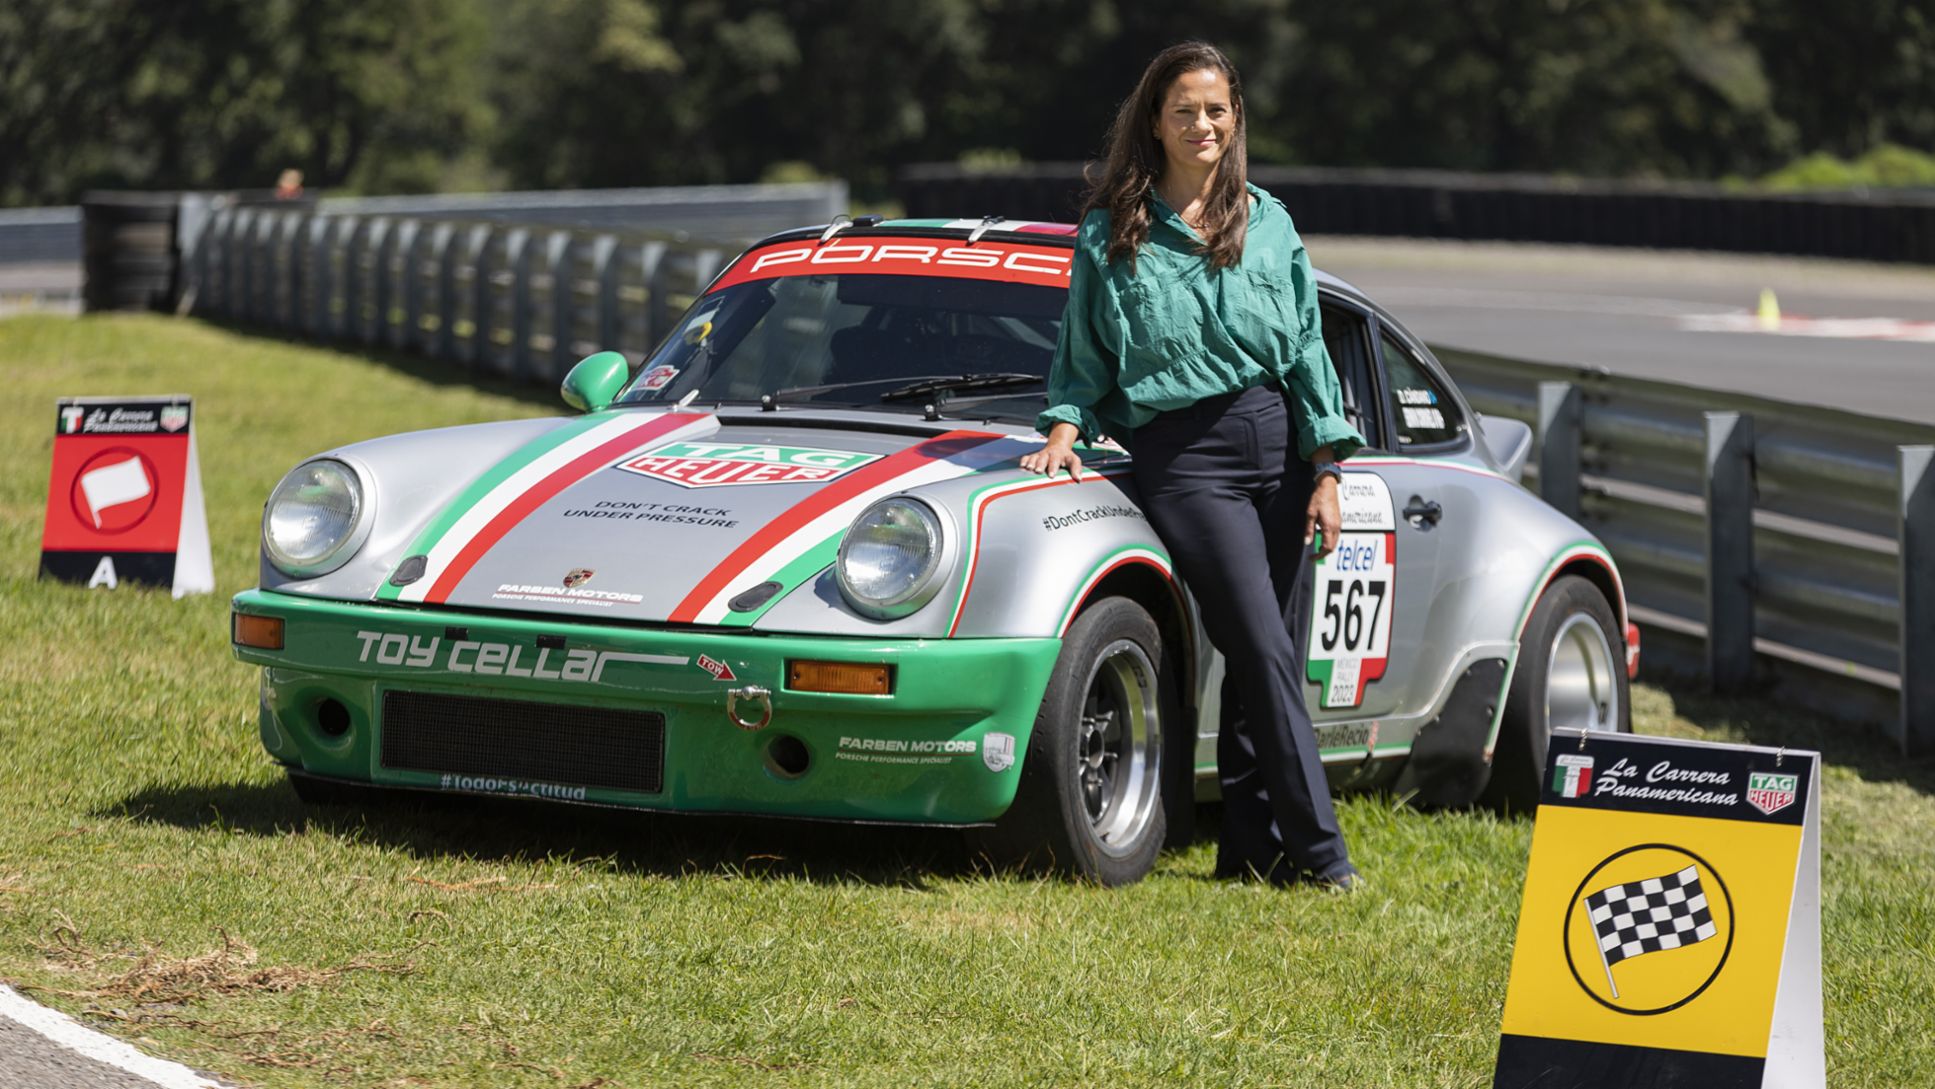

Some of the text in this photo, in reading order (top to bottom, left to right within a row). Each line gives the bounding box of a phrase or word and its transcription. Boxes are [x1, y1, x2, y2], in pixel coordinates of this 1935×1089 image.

[750, 244, 1074, 278] PORSC
[683, 444, 853, 466] TAG
[634, 457, 833, 484] HEUER
[563, 509, 740, 528] UNDER PRESSURE
[595, 501, 733, 516] DON'T CRACK
[1336, 538, 1378, 572] telcel
[88, 555, 118, 590] A
[497, 583, 643, 602] FARBEN MOTORS
[1321, 579, 1386, 652] 567
[357, 630, 441, 668] TOY
[701, 658, 724, 675] TOW
[1331, 684, 1355, 703] 2023
[839, 736, 977, 752] FARBEN MOTORS
[1602, 757, 1731, 785] La Carrera
[1594, 777, 1739, 806] Panamericana
[1753, 775, 1793, 791] TAG
[1750, 790, 1793, 812] HEUER
